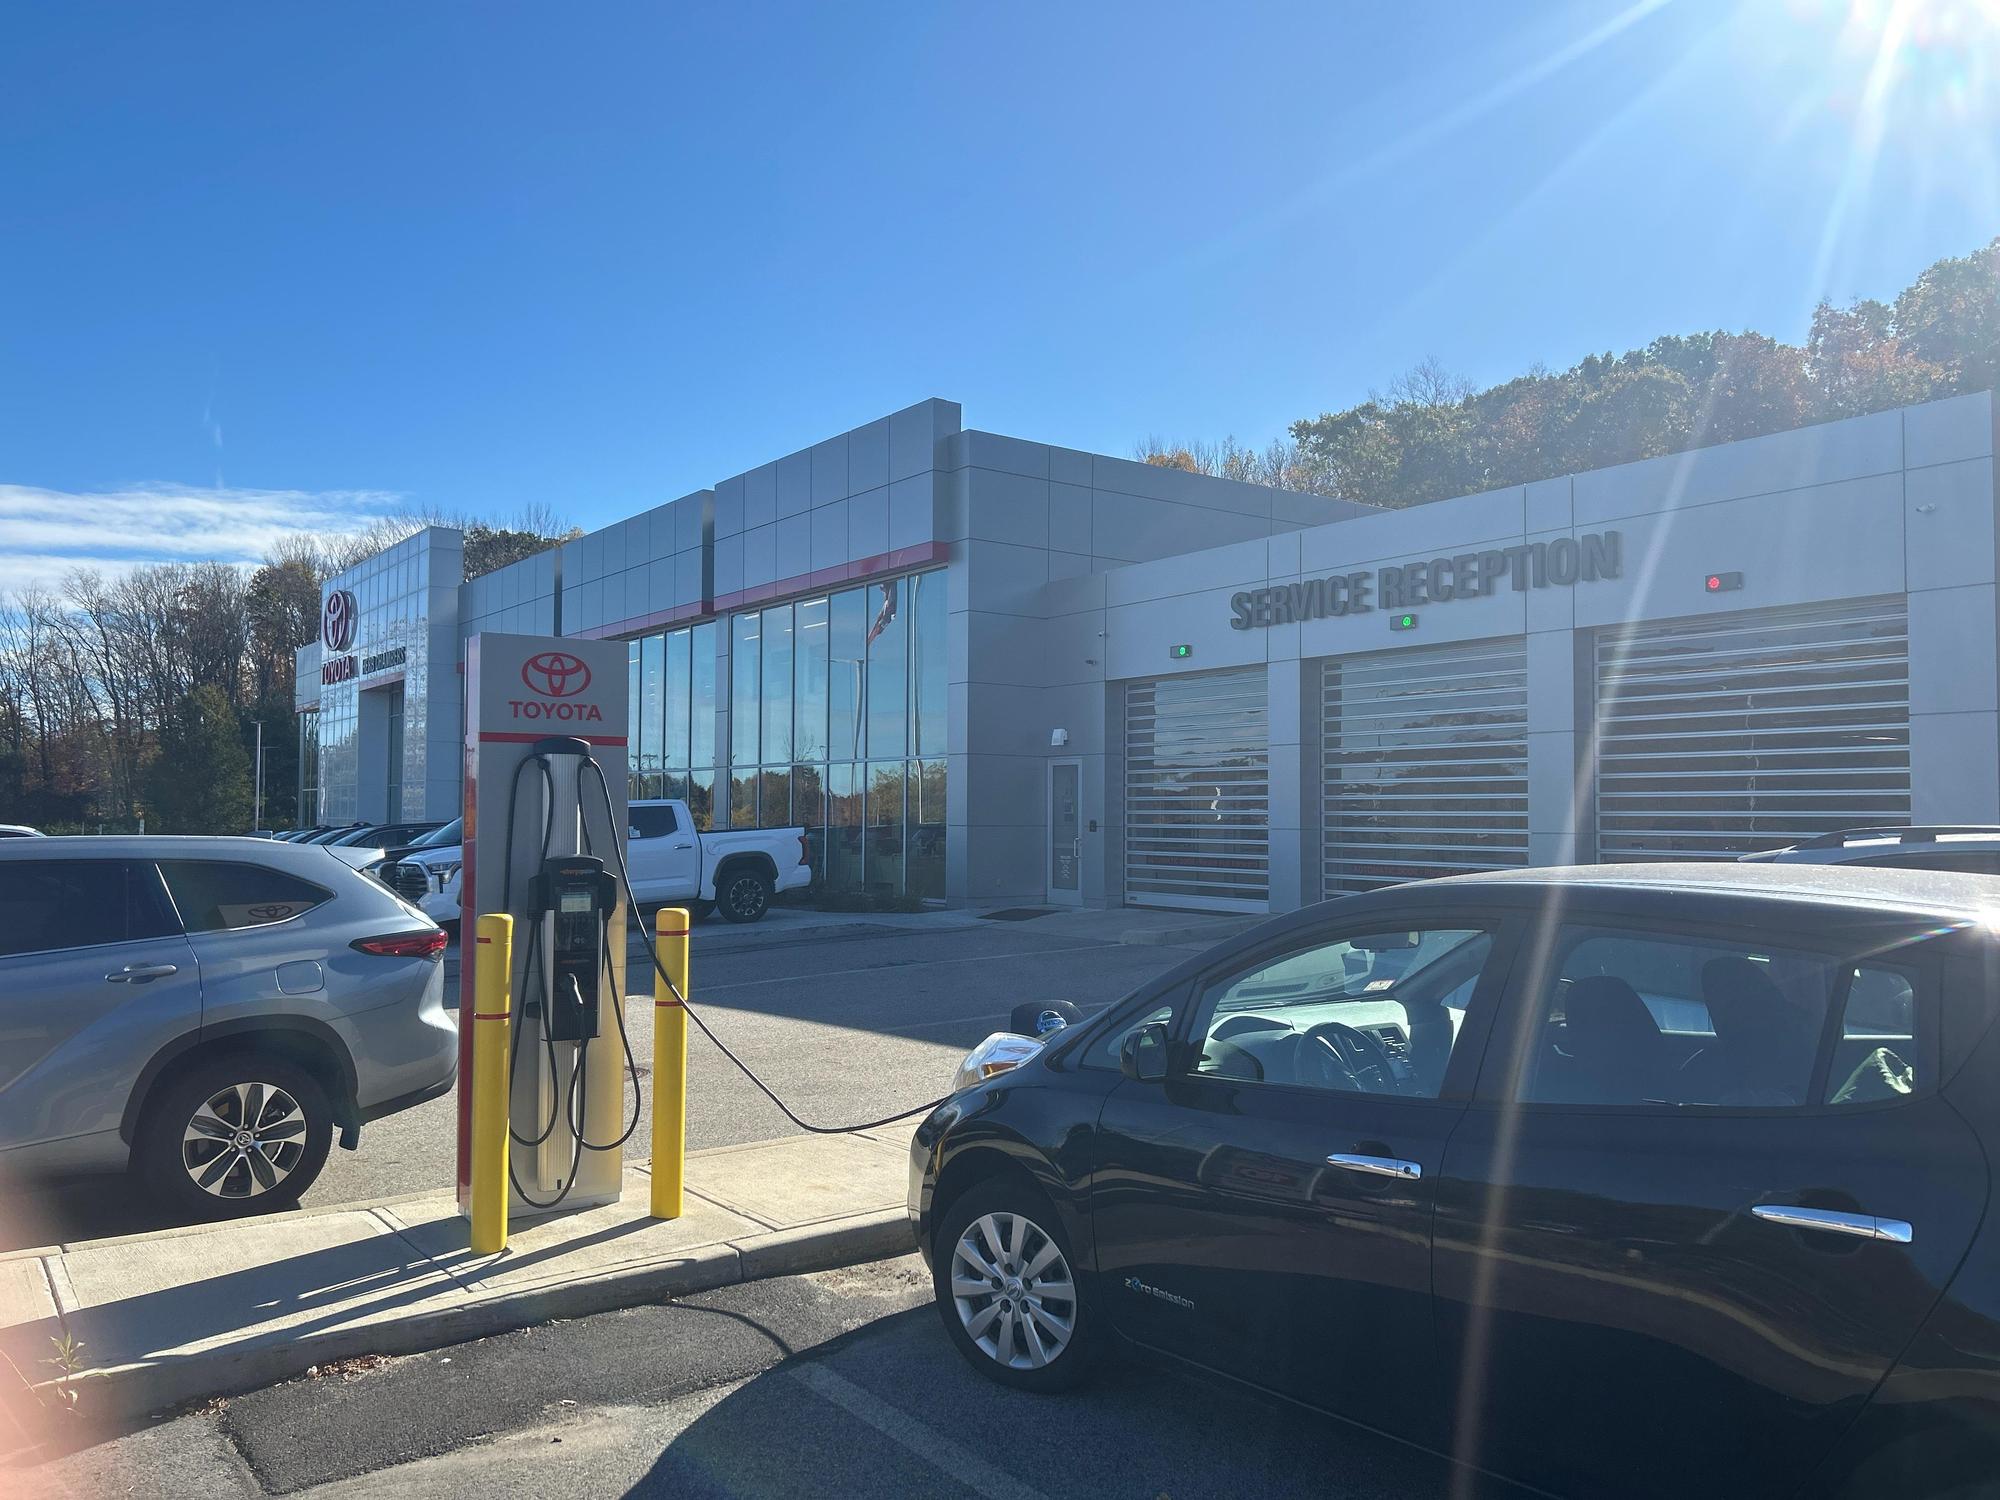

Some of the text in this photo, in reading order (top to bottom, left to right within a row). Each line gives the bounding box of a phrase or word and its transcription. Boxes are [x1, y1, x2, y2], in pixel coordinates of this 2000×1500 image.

[1230, 531, 1621, 630] SERVICE RECEPTION
[321, 656, 352, 685] TOYOTA
[508, 701, 602, 721] TOYOTA
